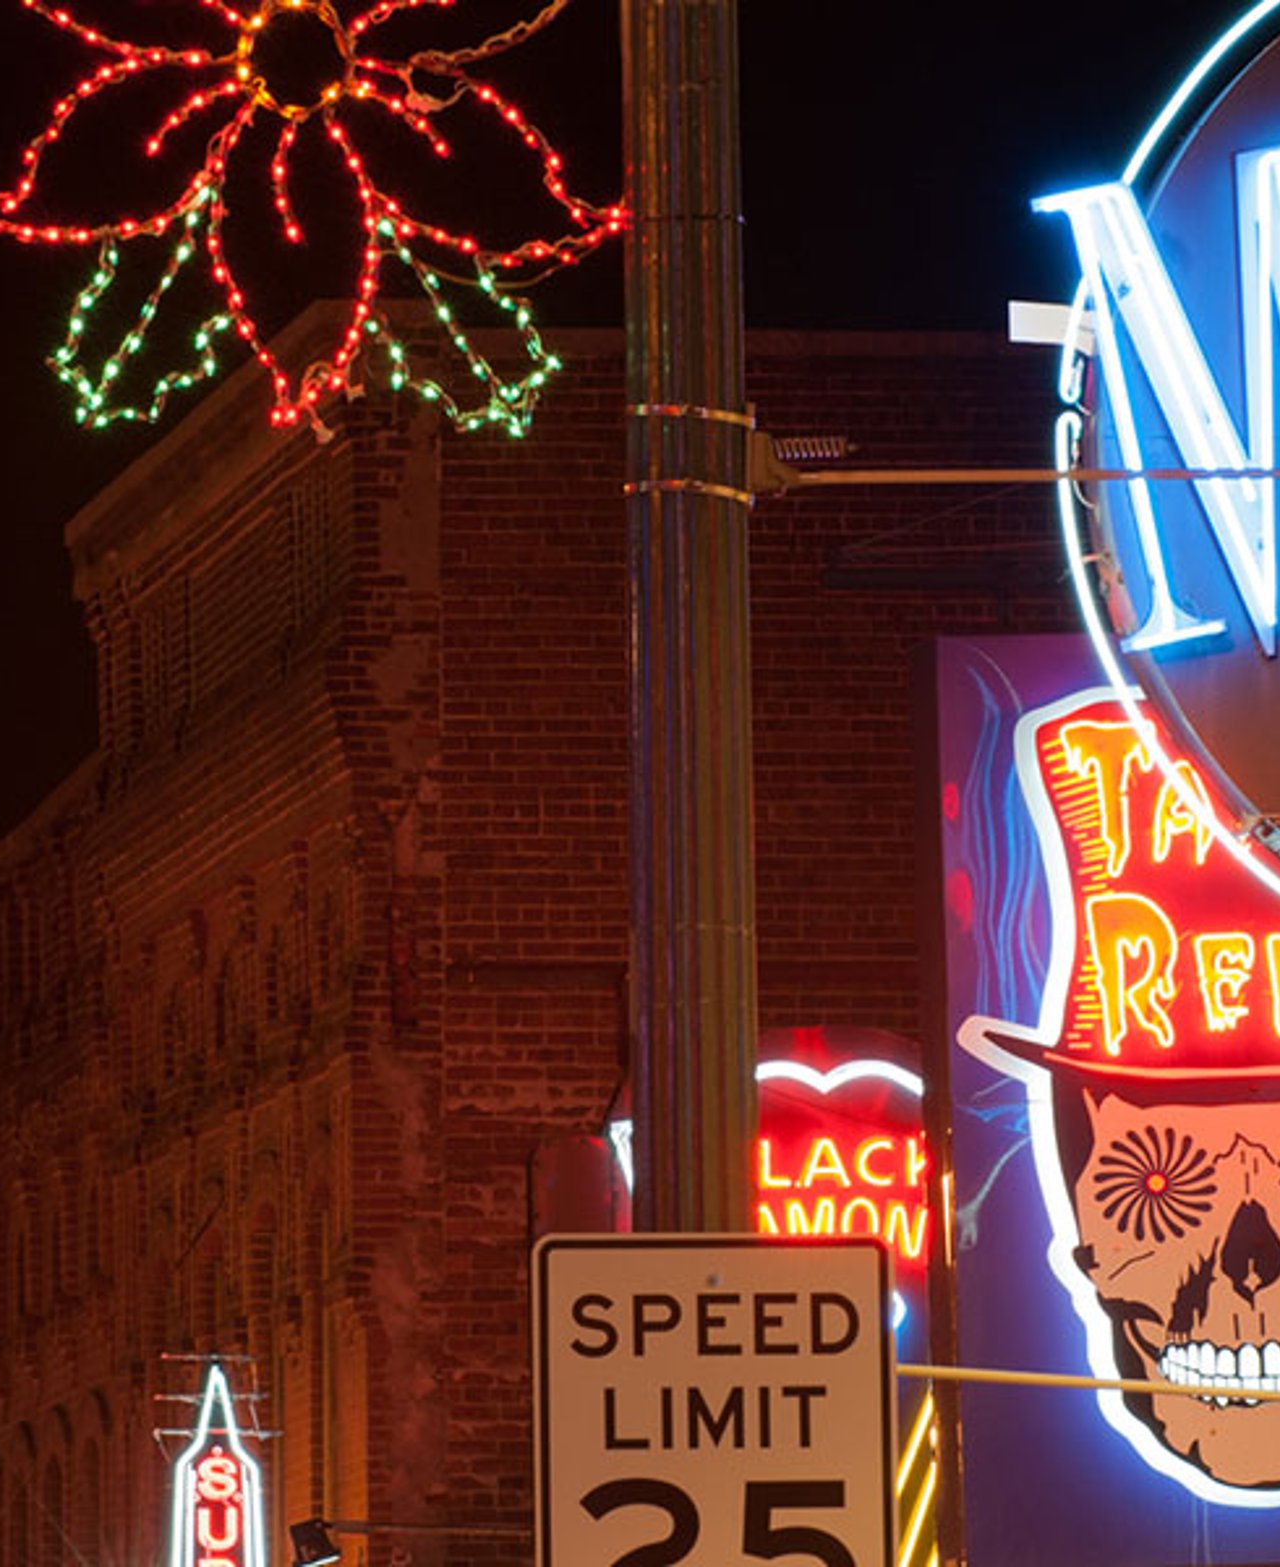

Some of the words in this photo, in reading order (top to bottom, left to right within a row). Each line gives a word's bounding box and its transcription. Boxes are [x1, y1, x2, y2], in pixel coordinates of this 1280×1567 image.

[570, 1292, 860, 1358] SPEED
[603, 1386, 828, 1450] LIMIT
[197, 1456, 239, 1567] SU
[579, 1477, 859, 1567] 25
